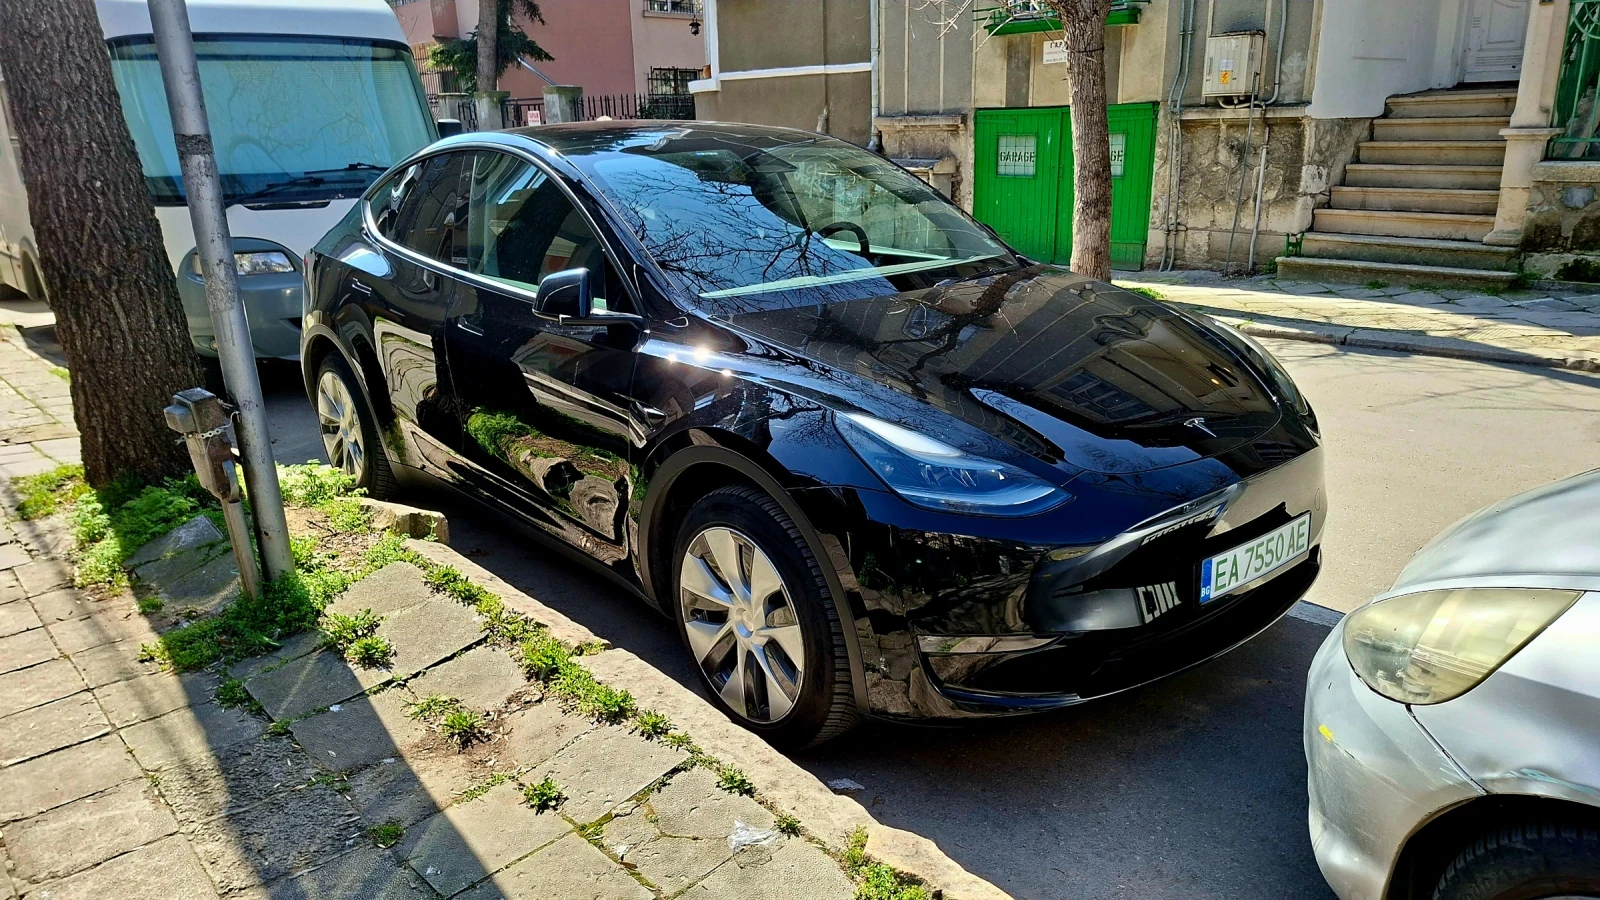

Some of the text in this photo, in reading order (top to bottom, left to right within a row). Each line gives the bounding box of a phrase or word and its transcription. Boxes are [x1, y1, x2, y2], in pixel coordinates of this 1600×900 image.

[1000, 151, 1035, 163] GARAGE
[1214, 519, 1307, 592] EA 7550 AE
[1200, 585, 1211, 598] BG
